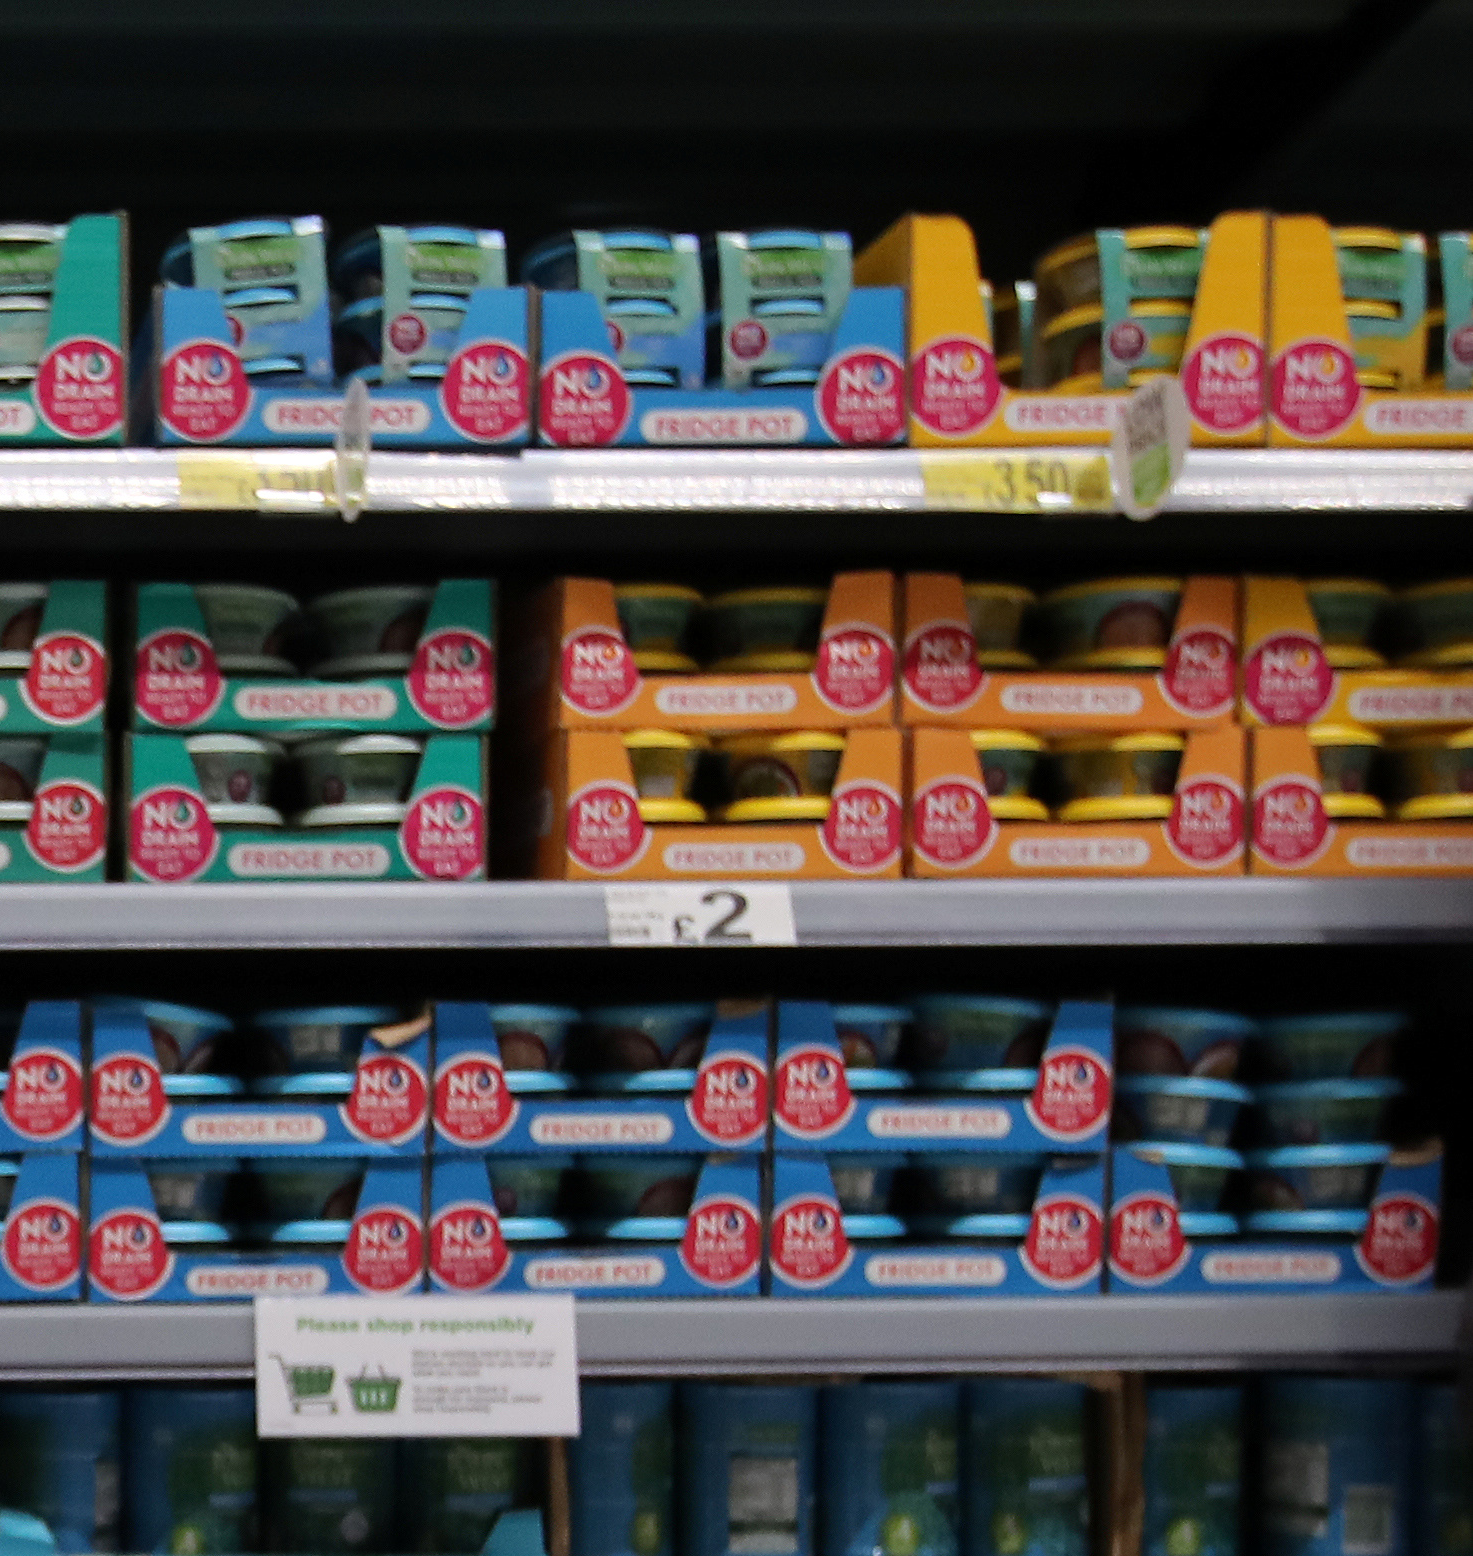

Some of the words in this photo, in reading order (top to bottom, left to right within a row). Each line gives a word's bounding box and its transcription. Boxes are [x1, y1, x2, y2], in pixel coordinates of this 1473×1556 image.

[55, 354, 111, 383] NO
[176, 354, 231, 385] NO
[460, 356, 515, 383] NO
[925, 354, 980, 380] NO
[1200, 350, 1255, 377] NO
[1286, 357, 1338, 384] NO
[553, 369, 608, 396] NO
[837, 367, 893, 395] NO
[279, 407, 342, 425] FRIDG
[371, 407, 414, 426] POT
[749, 416, 792, 434] POT
[41, 647, 93, 674] NO
[149, 642, 201, 671] NO
[426, 641, 480, 669] NO
[572, 641, 624, 667] NO
[331, 691, 384, 713] POT
[40, 795, 93, 822] NO
[141, 801, 194, 829] NO
[420, 800, 474, 829] NO
[574, 802, 626, 827] NO
[239, 848, 318, 870] FRIDGE
[327, 846, 376, 869] POT
[673, 890, 752, 941] £2
[15, 1063, 65, 1089] NO
[100, 1071, 150, 1094] NO
[359, 1070, 409, 1094] NO
[450, 1070, 496, 1094] NO
[702, 1068, 753, 1094] NO
[787, 1062, 838, 1087] NO
[1044, 1063, 1094, 1088] NO
[276, 1117, 315, 1137] POT
[18, 1214, 68, 1238] NO
[359, 1222, 407, 1247] NO
[442, 1219, 489, 1245] NO
[696, 1211, 745, 1236] NO
[782, 1210, 835, 1235] NO
[1035, 1211, 1087, 1236] NO
[1121, 1210, 1173, 1234] NO
[104, 1227, 150, 1250] NO
[297, 1317, 359, 1332] Please
[367, 1319, 414, 1334] shop
[420, 1317, 534, 1335] responsibly
